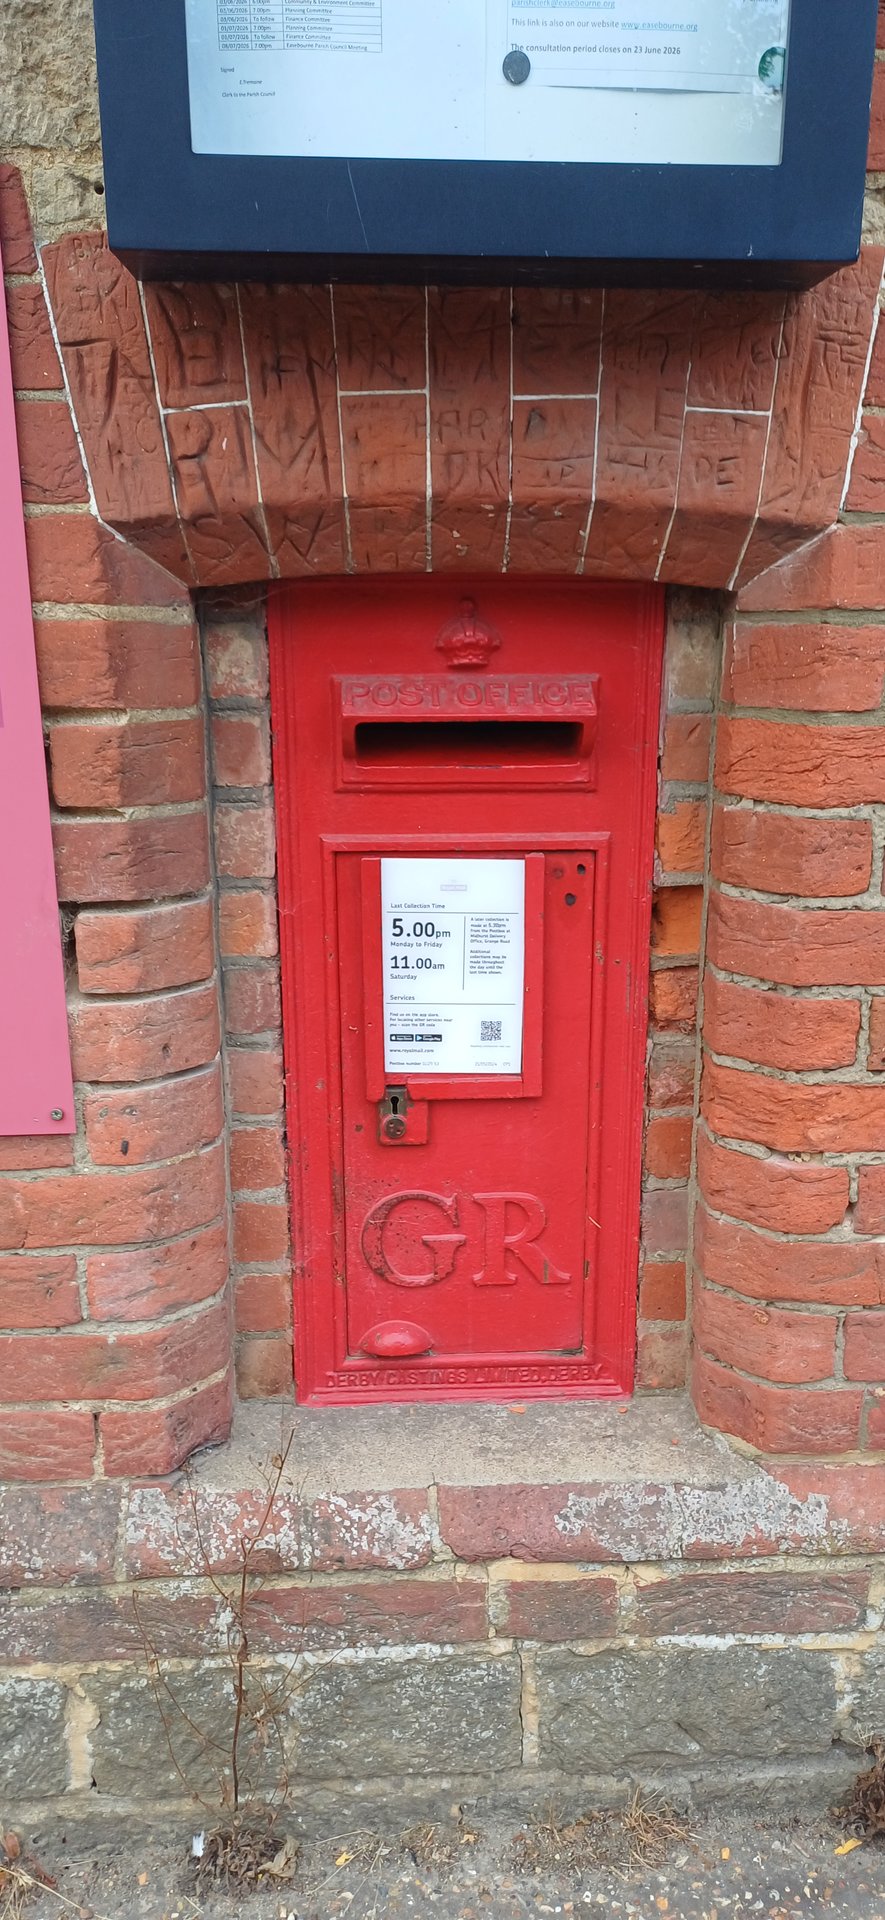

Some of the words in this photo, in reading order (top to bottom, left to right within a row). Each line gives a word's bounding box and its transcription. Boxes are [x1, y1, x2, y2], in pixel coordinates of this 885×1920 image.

[512, 0, 616, 9] parishclerk@easebourne.org
[621, 21, 698, 32] www.easebourne.org
[573, 45, 597, 53] period
[345, 682, 446, 707] POST
[456, 682, 594, 708] OFFICE
[392, 918, 451, 939] 5.00pm
[390, 955, 445, 969] 11.00am
[361, 1189, 572, 1287] GR
[326, 1371, 380, 1387] DERBY
[388, 1368, 466, 1386] CASTINGS
[549, 1364, 602, 1382] DERBY
